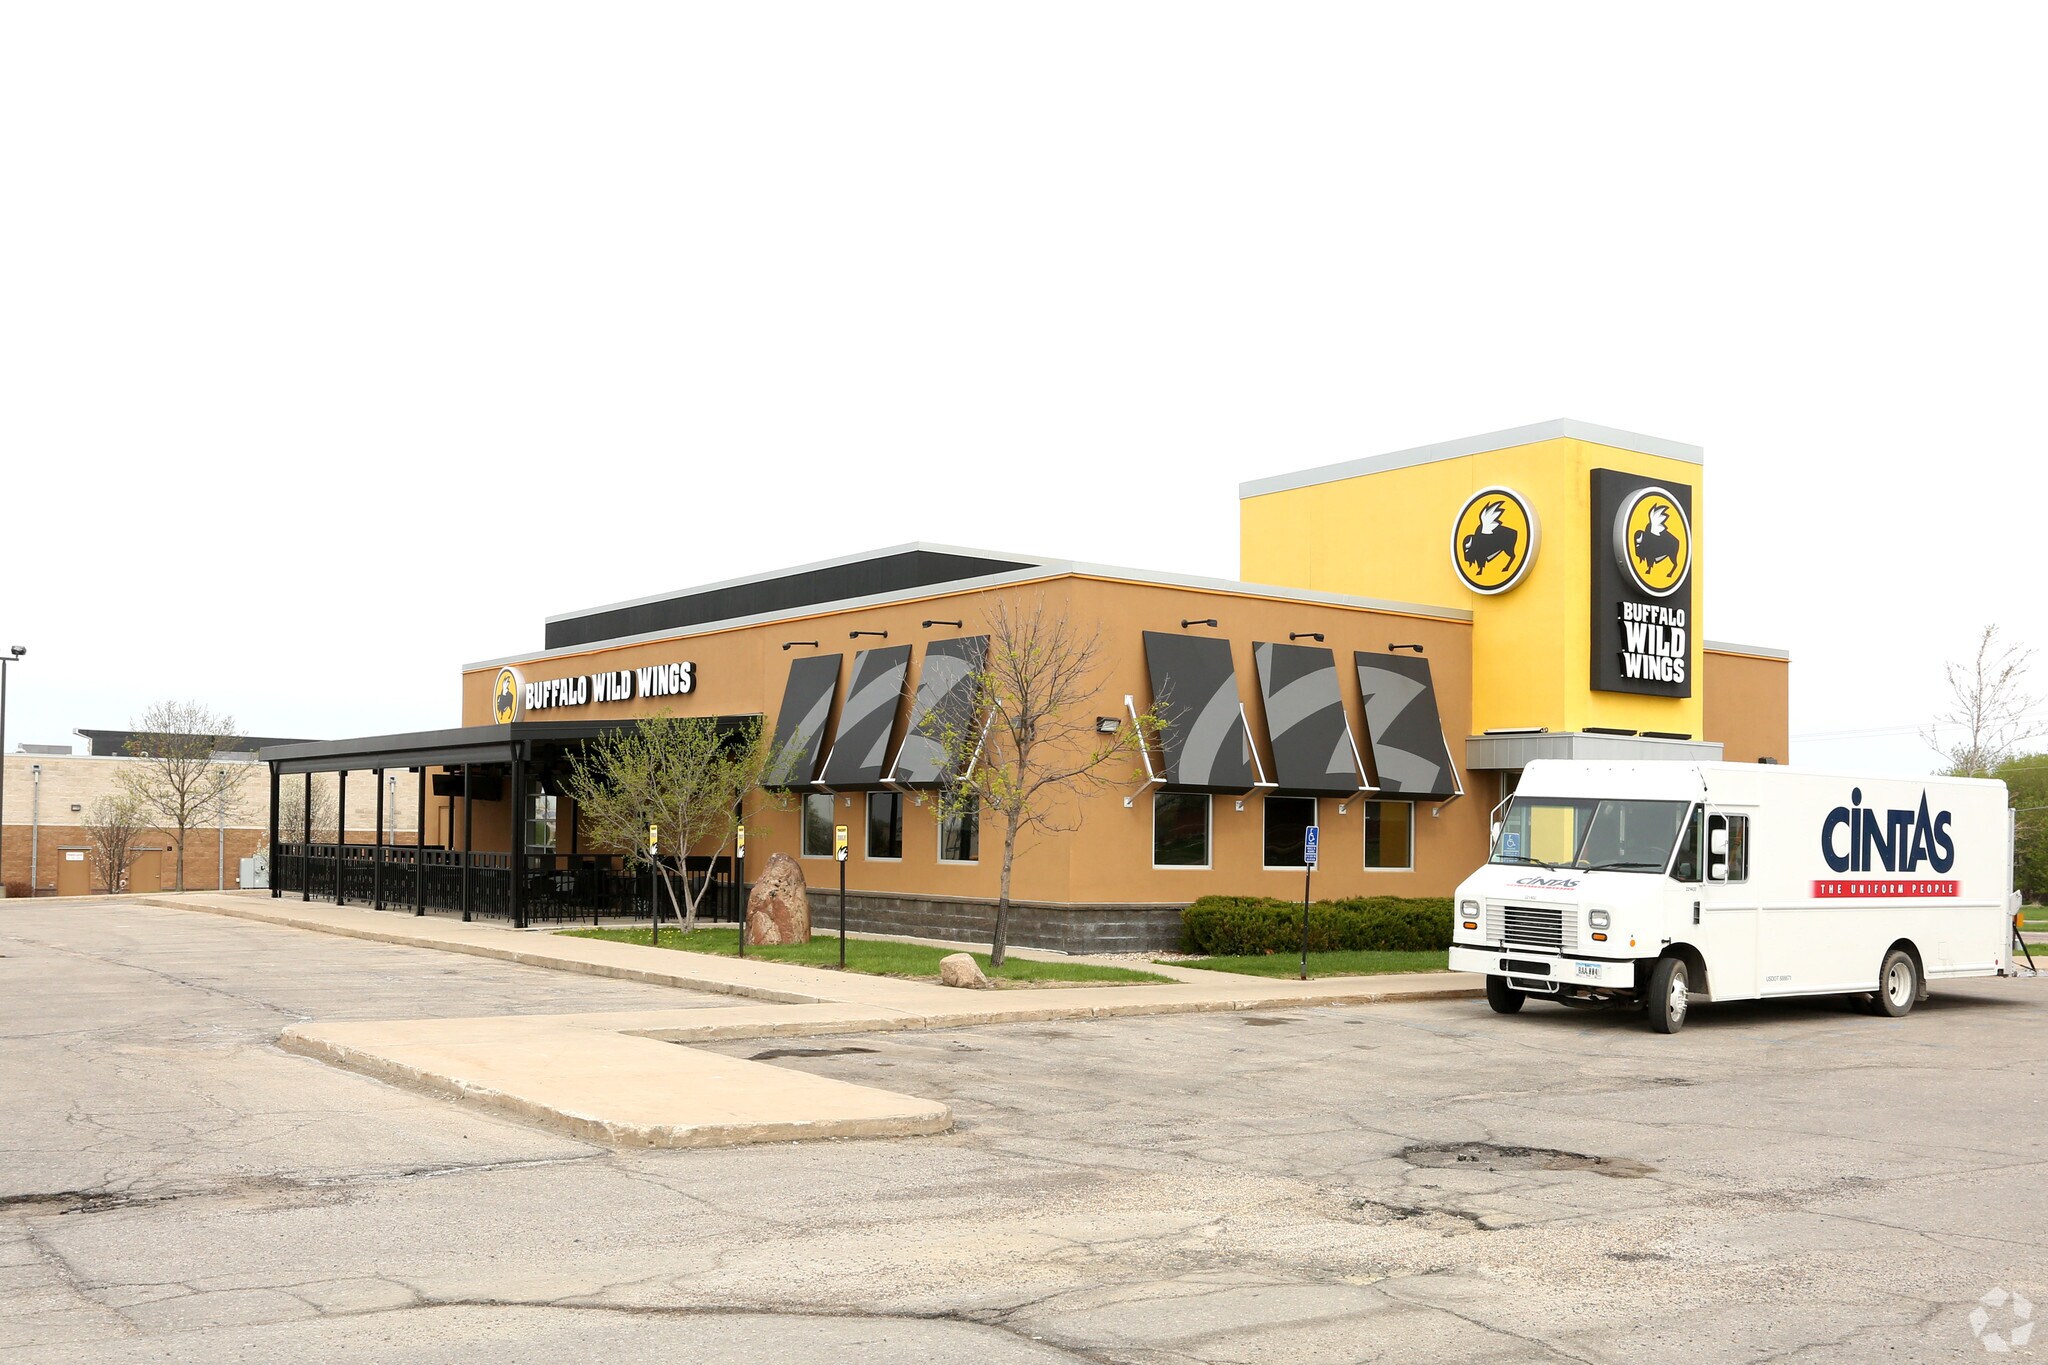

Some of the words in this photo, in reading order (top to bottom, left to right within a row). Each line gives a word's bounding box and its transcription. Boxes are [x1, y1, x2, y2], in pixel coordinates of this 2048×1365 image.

[1622, 601, 1686, 628] BUFFALO
[1623, 620, 1686, 659] WILD
[1622, 652, 1685, 684] WINGS
[525, 675, 588, 710] BUFFALO
[592, 669, 632, 703] WILD
[636, 661, 692, 698] WINGS
[1821, 884, 1842, 894] THE
[1851, 884, 1904, 894] UNIFORM
[1911, 884, 1953, 894] PEOPLE
